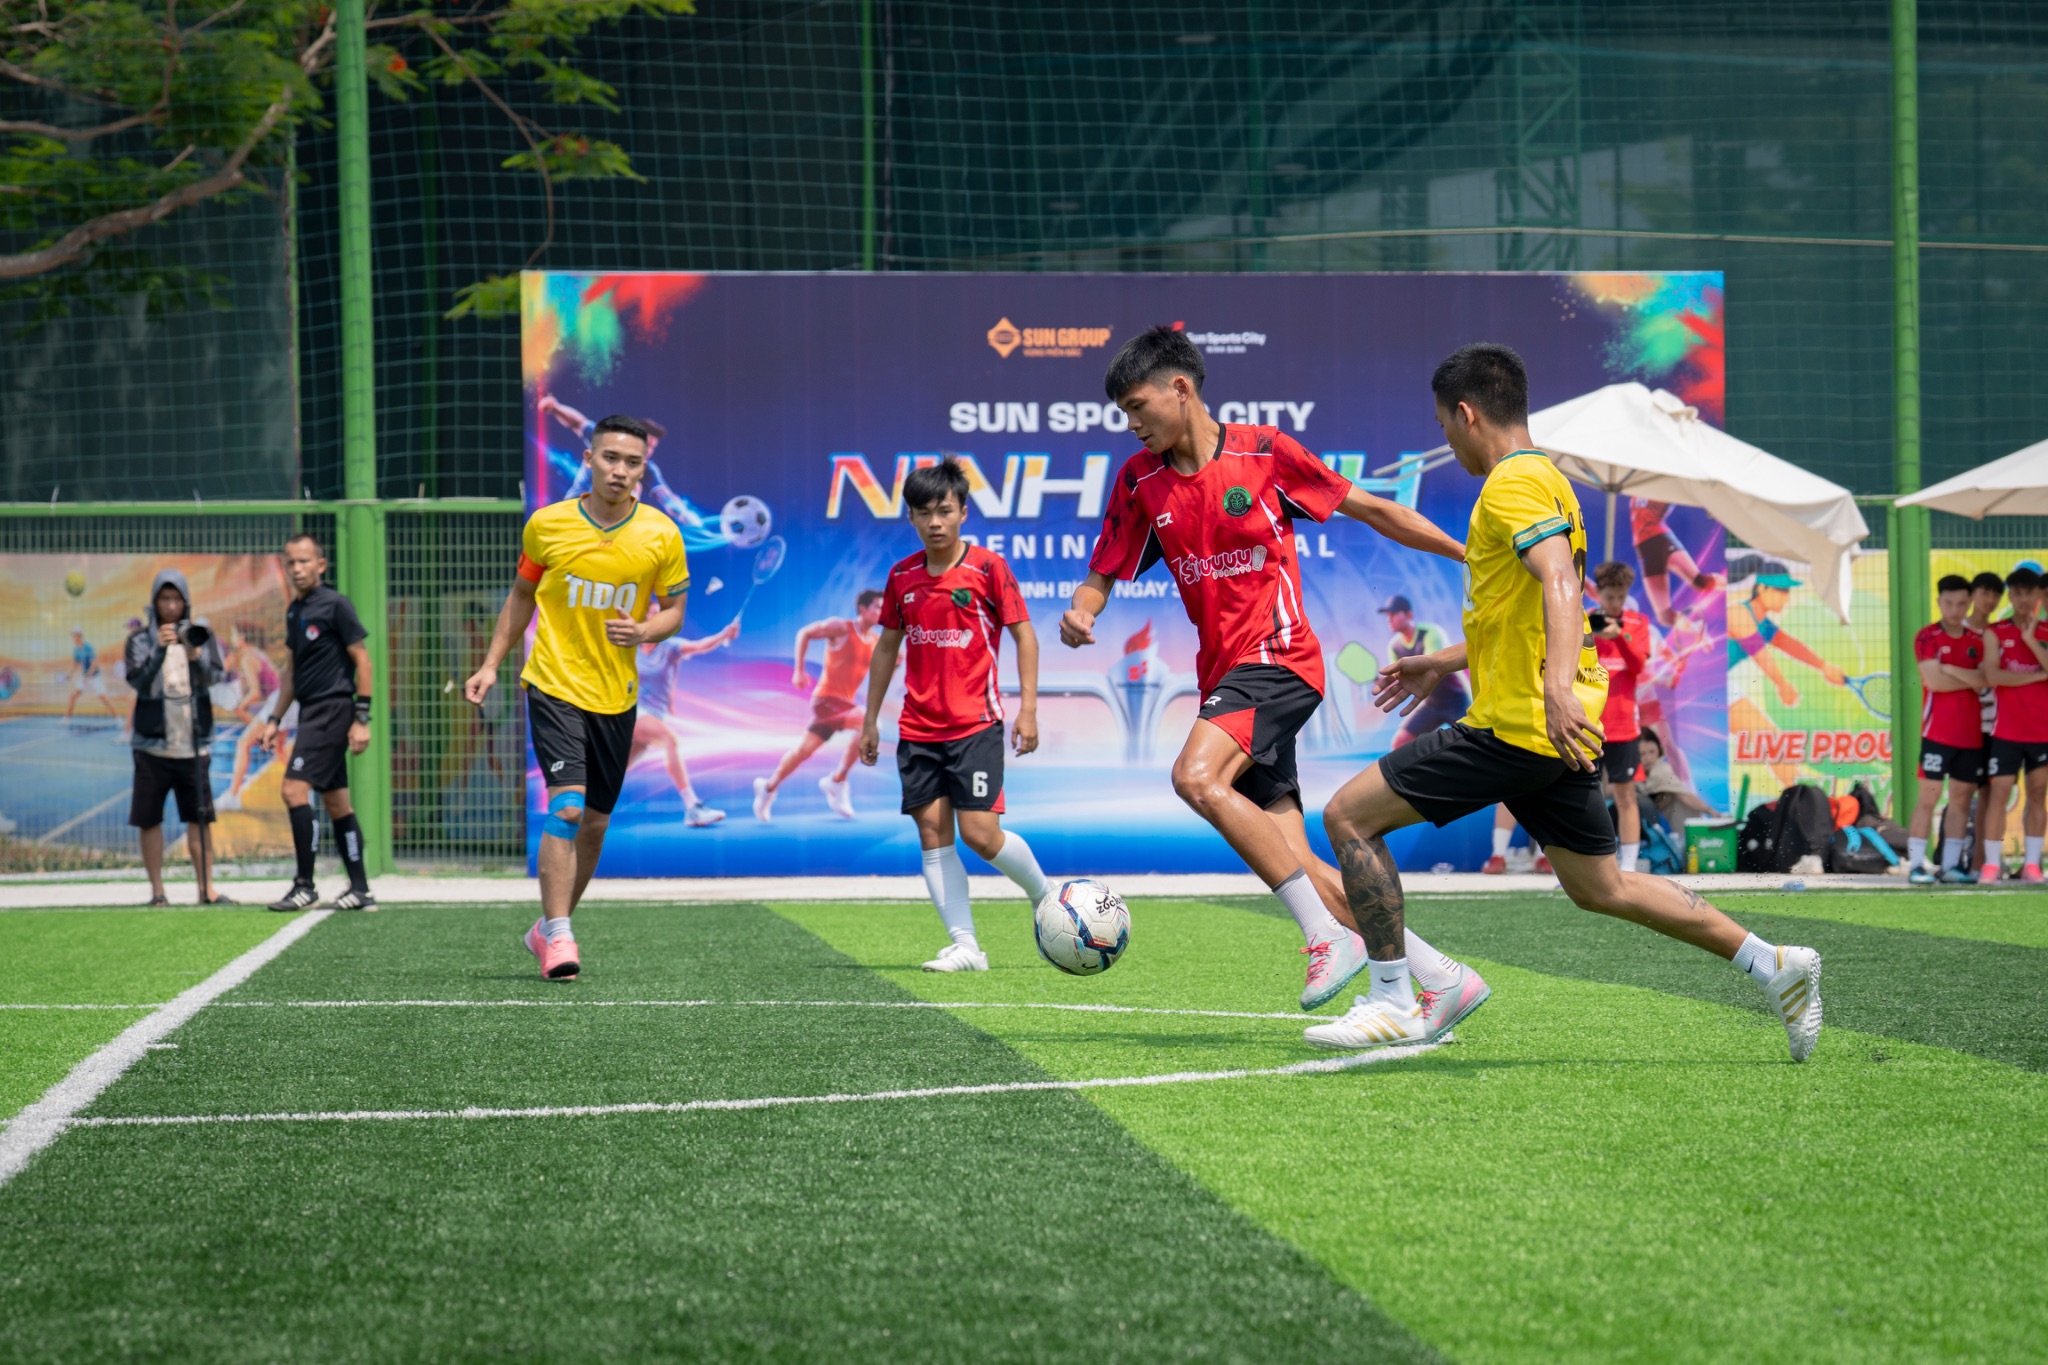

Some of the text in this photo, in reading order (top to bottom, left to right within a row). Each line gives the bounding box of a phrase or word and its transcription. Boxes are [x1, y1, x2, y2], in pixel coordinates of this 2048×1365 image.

[1023, 328, 1111, 347] SUN GROUP
[1206, 332, 1242, 345] Sports
[1242, 332, 1266, 346] City
[949, 402, 1039, 433] SUN
[1218, 401, 1315, 432] CITY
[826, 453, 1110, 519] NNH
[564, 573, 638, 614] TIDO
[1019, 581, 1055, 599] INH
[1736, 730, 1893, 763] LIVE PROU
[1923, 753, 1943, 773] 22
[972, 771, 988, 798] 6
